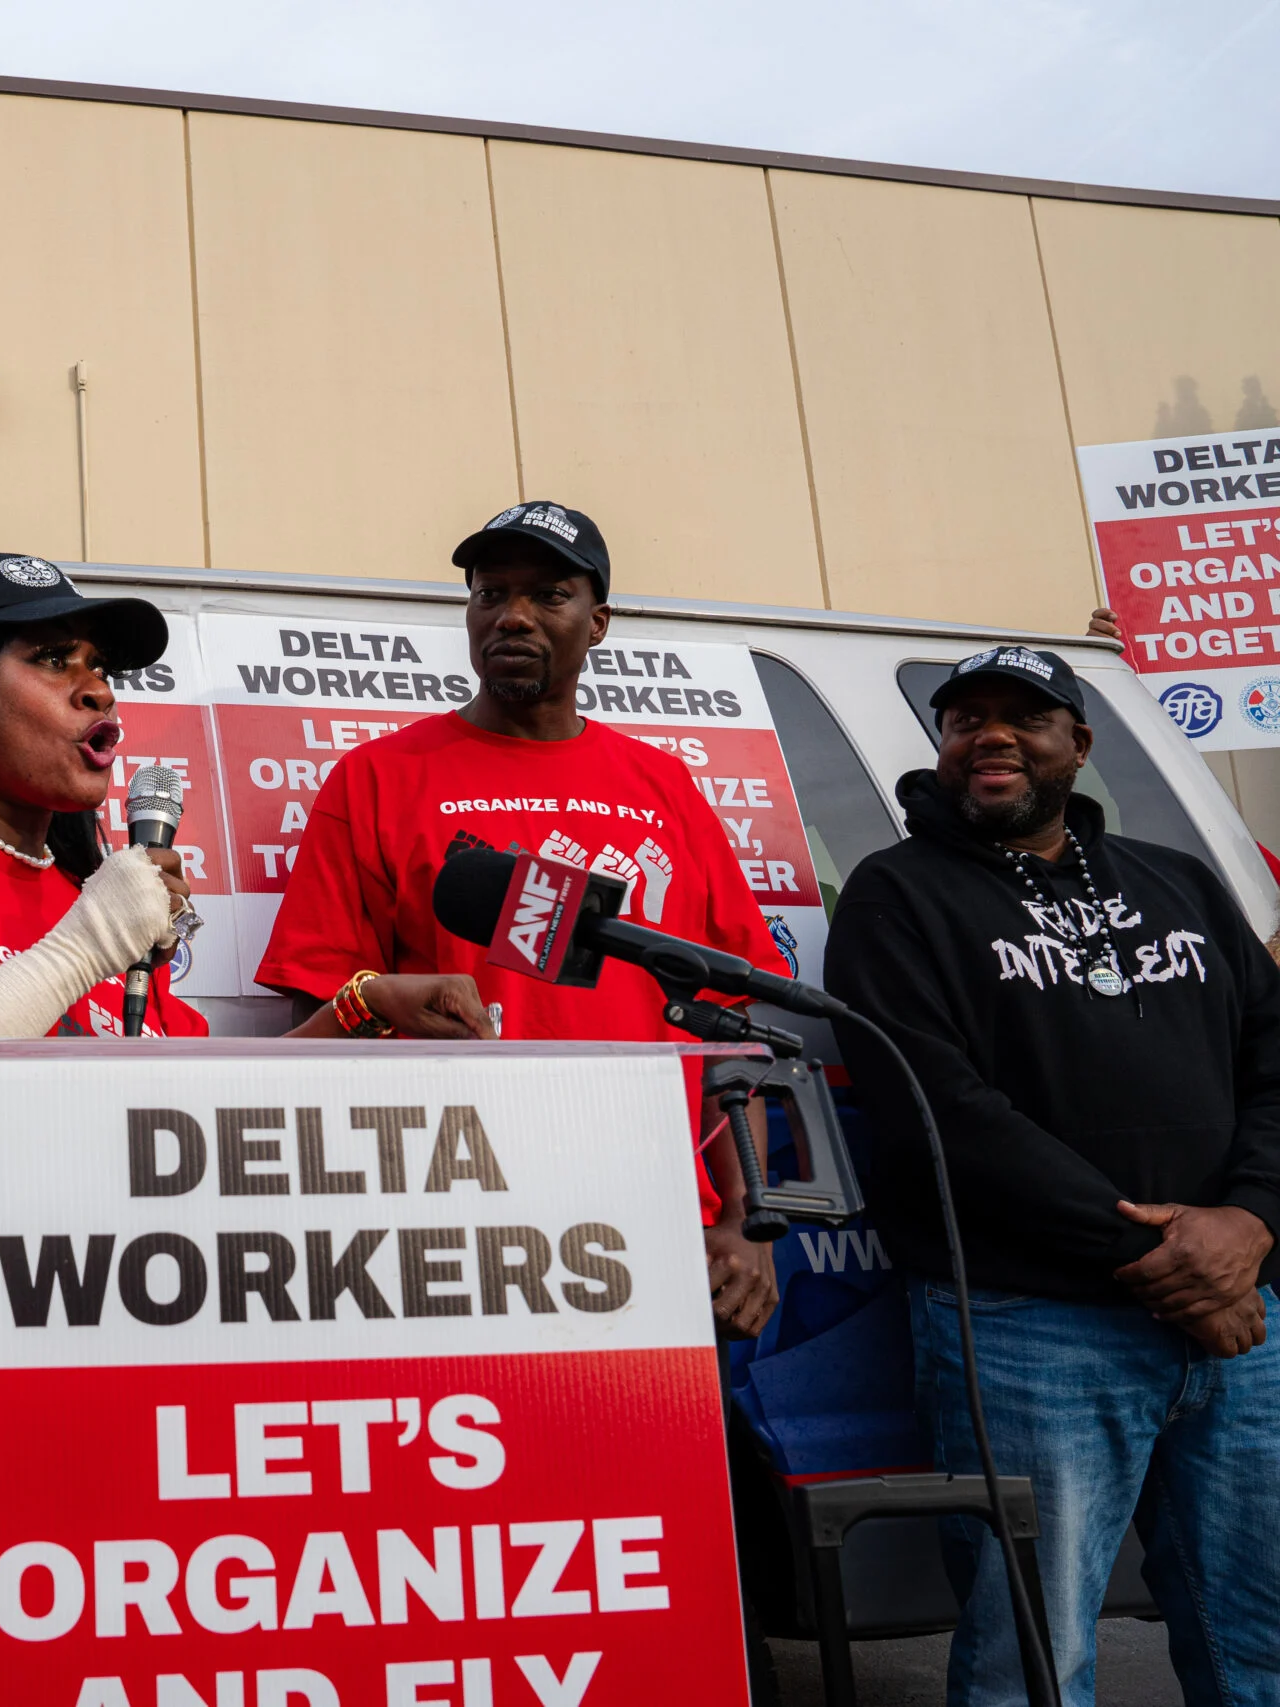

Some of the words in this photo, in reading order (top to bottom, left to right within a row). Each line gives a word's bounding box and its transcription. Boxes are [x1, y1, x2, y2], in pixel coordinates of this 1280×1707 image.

[524, 512, 544, 521] HIS
[544, 514, 579, 537] DREAM
[533, 519, 550, 529] OUR
[549, 525, 576, 543] DREAM
[1177, 518, 1280, 550] LET’
[1159, 591, 1255, 624] AND
[279, 629, 422, 664] DELTA
[578, 648, 693, 679] ELTA
[999, 654, 1018, 662] HIS
[1019, 656, 1053, 674] DREAM
[1007, 661, 1025, 669] OUR
[1025, 664, 1052, 681] DREAM
[237, 664, 473, 703] WORKERS
[576, 683, 742, 718] ORKERS
[302, 719, 408, 750] LET’
[696, 776, 773, 808] IZE
[439, 798, 559, 815] ORGANIZE
[566, 798, 611, 816] AND
[617, 805, 663, 829] FLY,
[507, 860, 559, 966] ANF
[538, 932, 555, 970] ATLANTA
[551, 904, 564, 931] NEWS
[559, 876, 573, 902] FIRST
[126, 1104, 508, 1198] DELTA
[155, 1393, 506, 1501] LET’S
